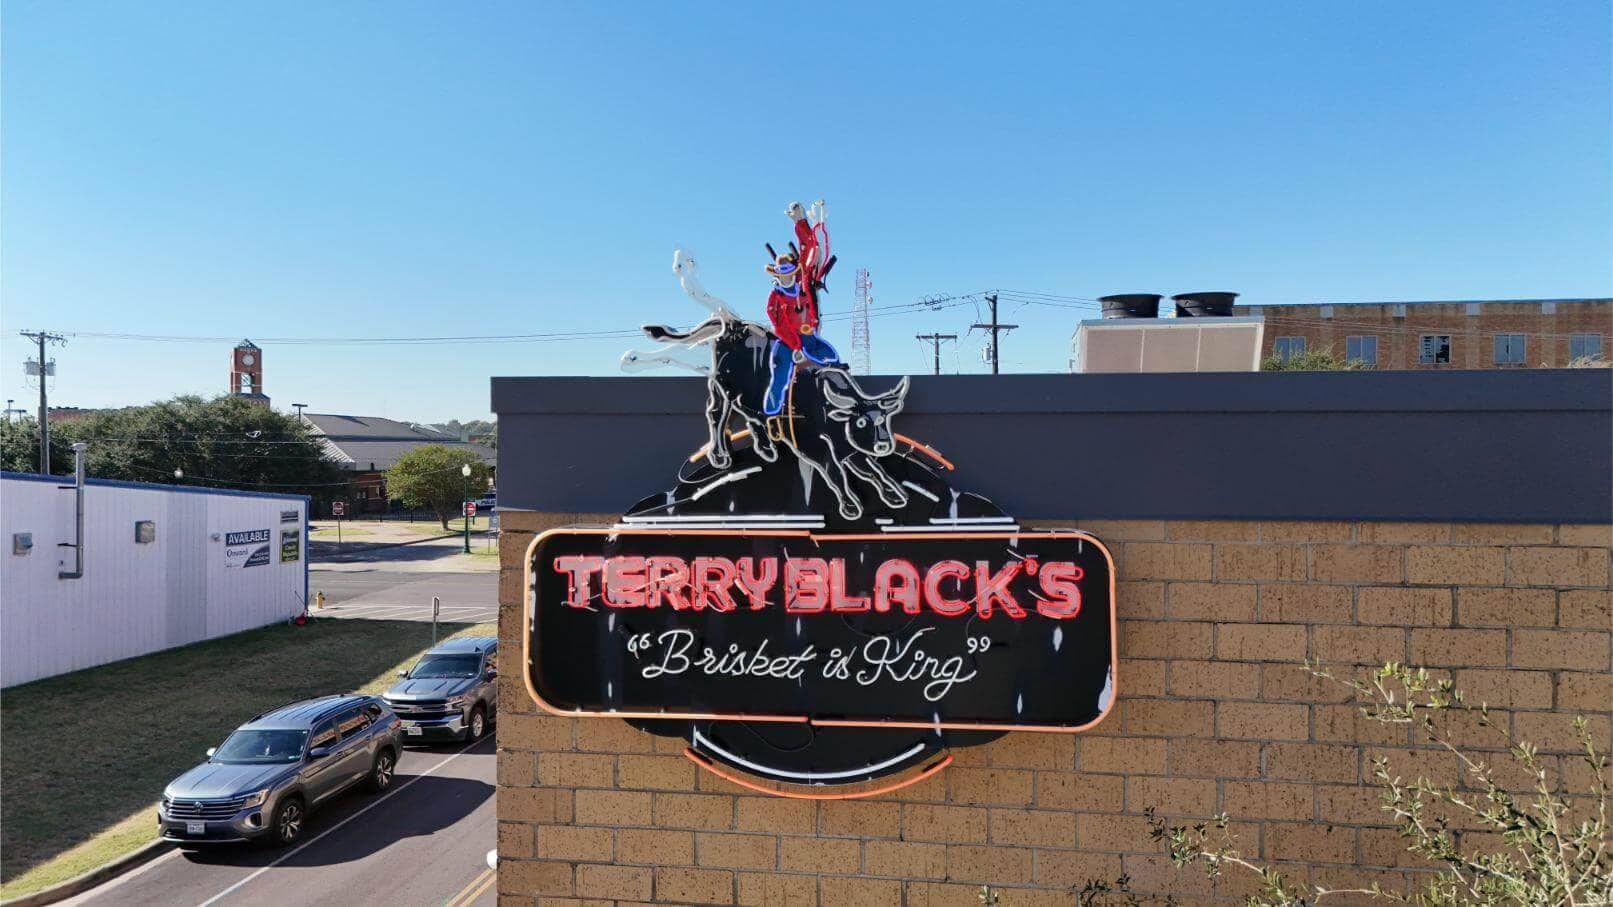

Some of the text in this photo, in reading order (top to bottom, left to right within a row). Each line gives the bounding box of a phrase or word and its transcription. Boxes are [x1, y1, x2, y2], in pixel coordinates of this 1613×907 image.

[228, 531, 268, 545] AVAILABLE
[554, 554, 1084, 619] TERRY BLACK'S
[822, 648, 850, 680] is
